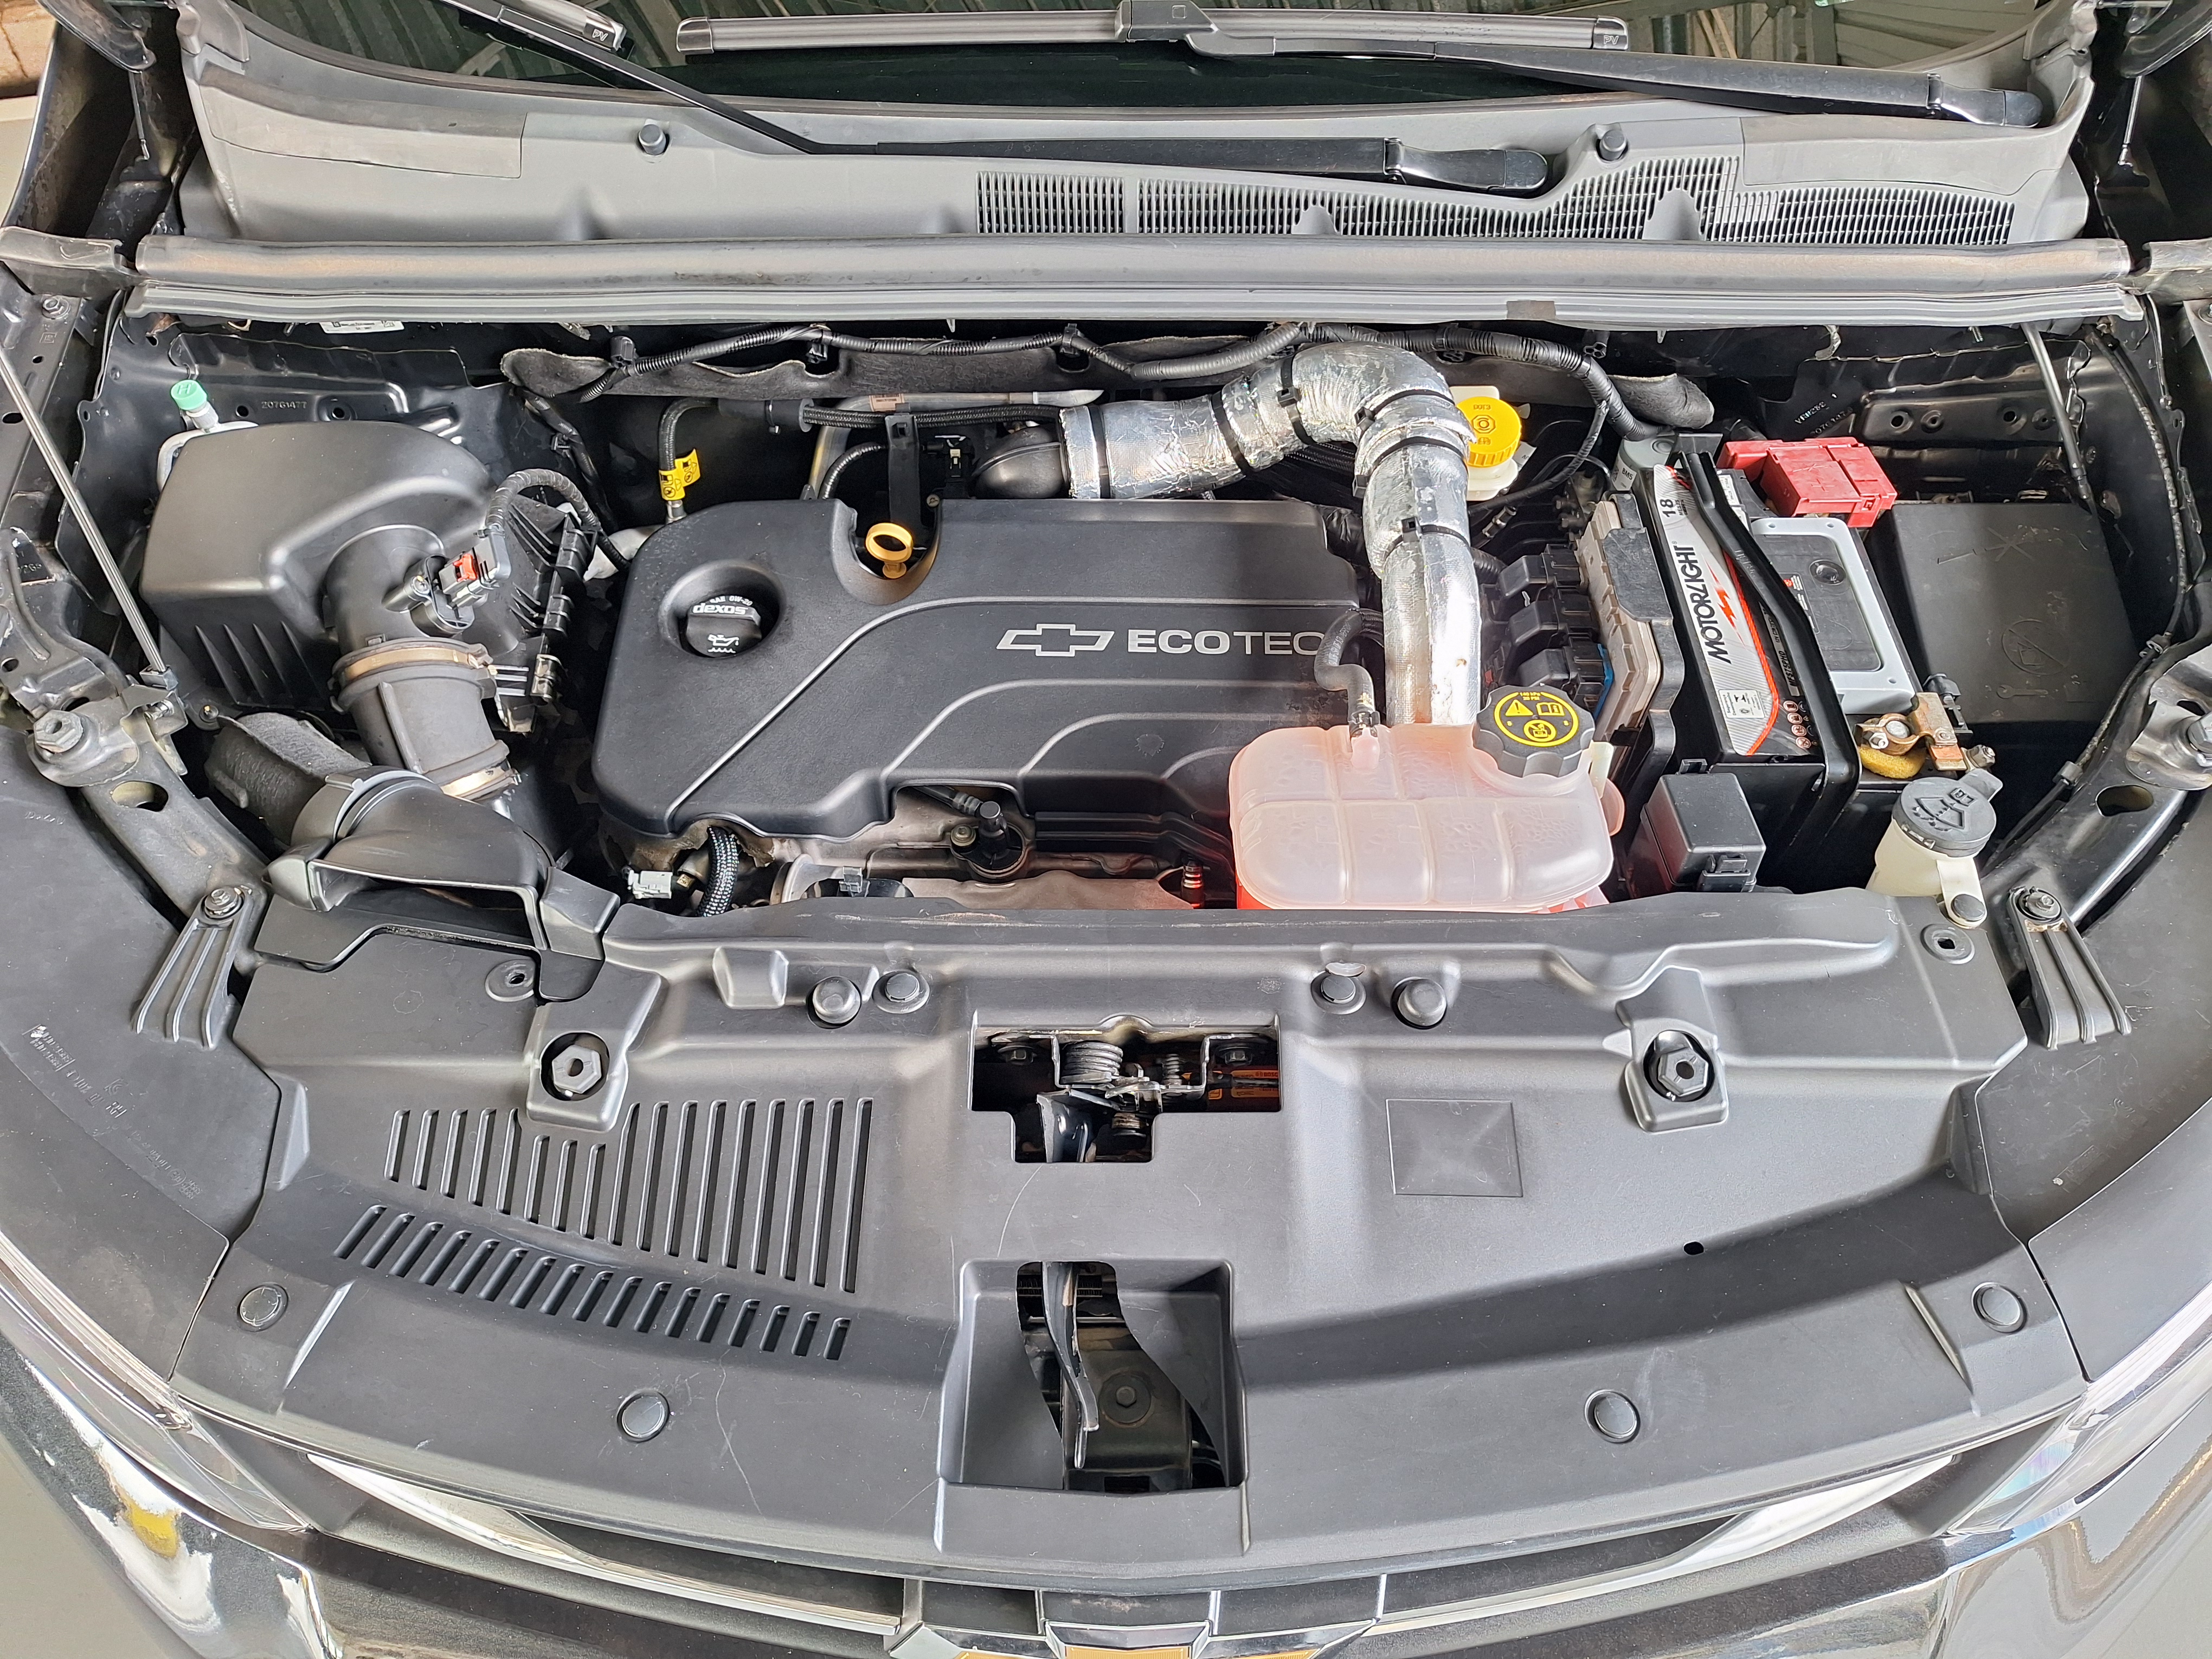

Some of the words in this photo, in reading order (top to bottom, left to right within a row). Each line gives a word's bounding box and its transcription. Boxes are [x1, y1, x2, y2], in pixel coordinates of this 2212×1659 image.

[1604, 35, 1619, 45] PV
[177, 383, 191, 395] H
[1622, 467, 1634, 480] BM5
[1660, 499, 1676, 518] 18
[729, 595, 753, 606] 0W-20
[1673, 545, 1732, 665] MOTORLIGHT
[692, 602, 749, 615] dexos
[1128, 629, 1324, 654] ECOTEC
